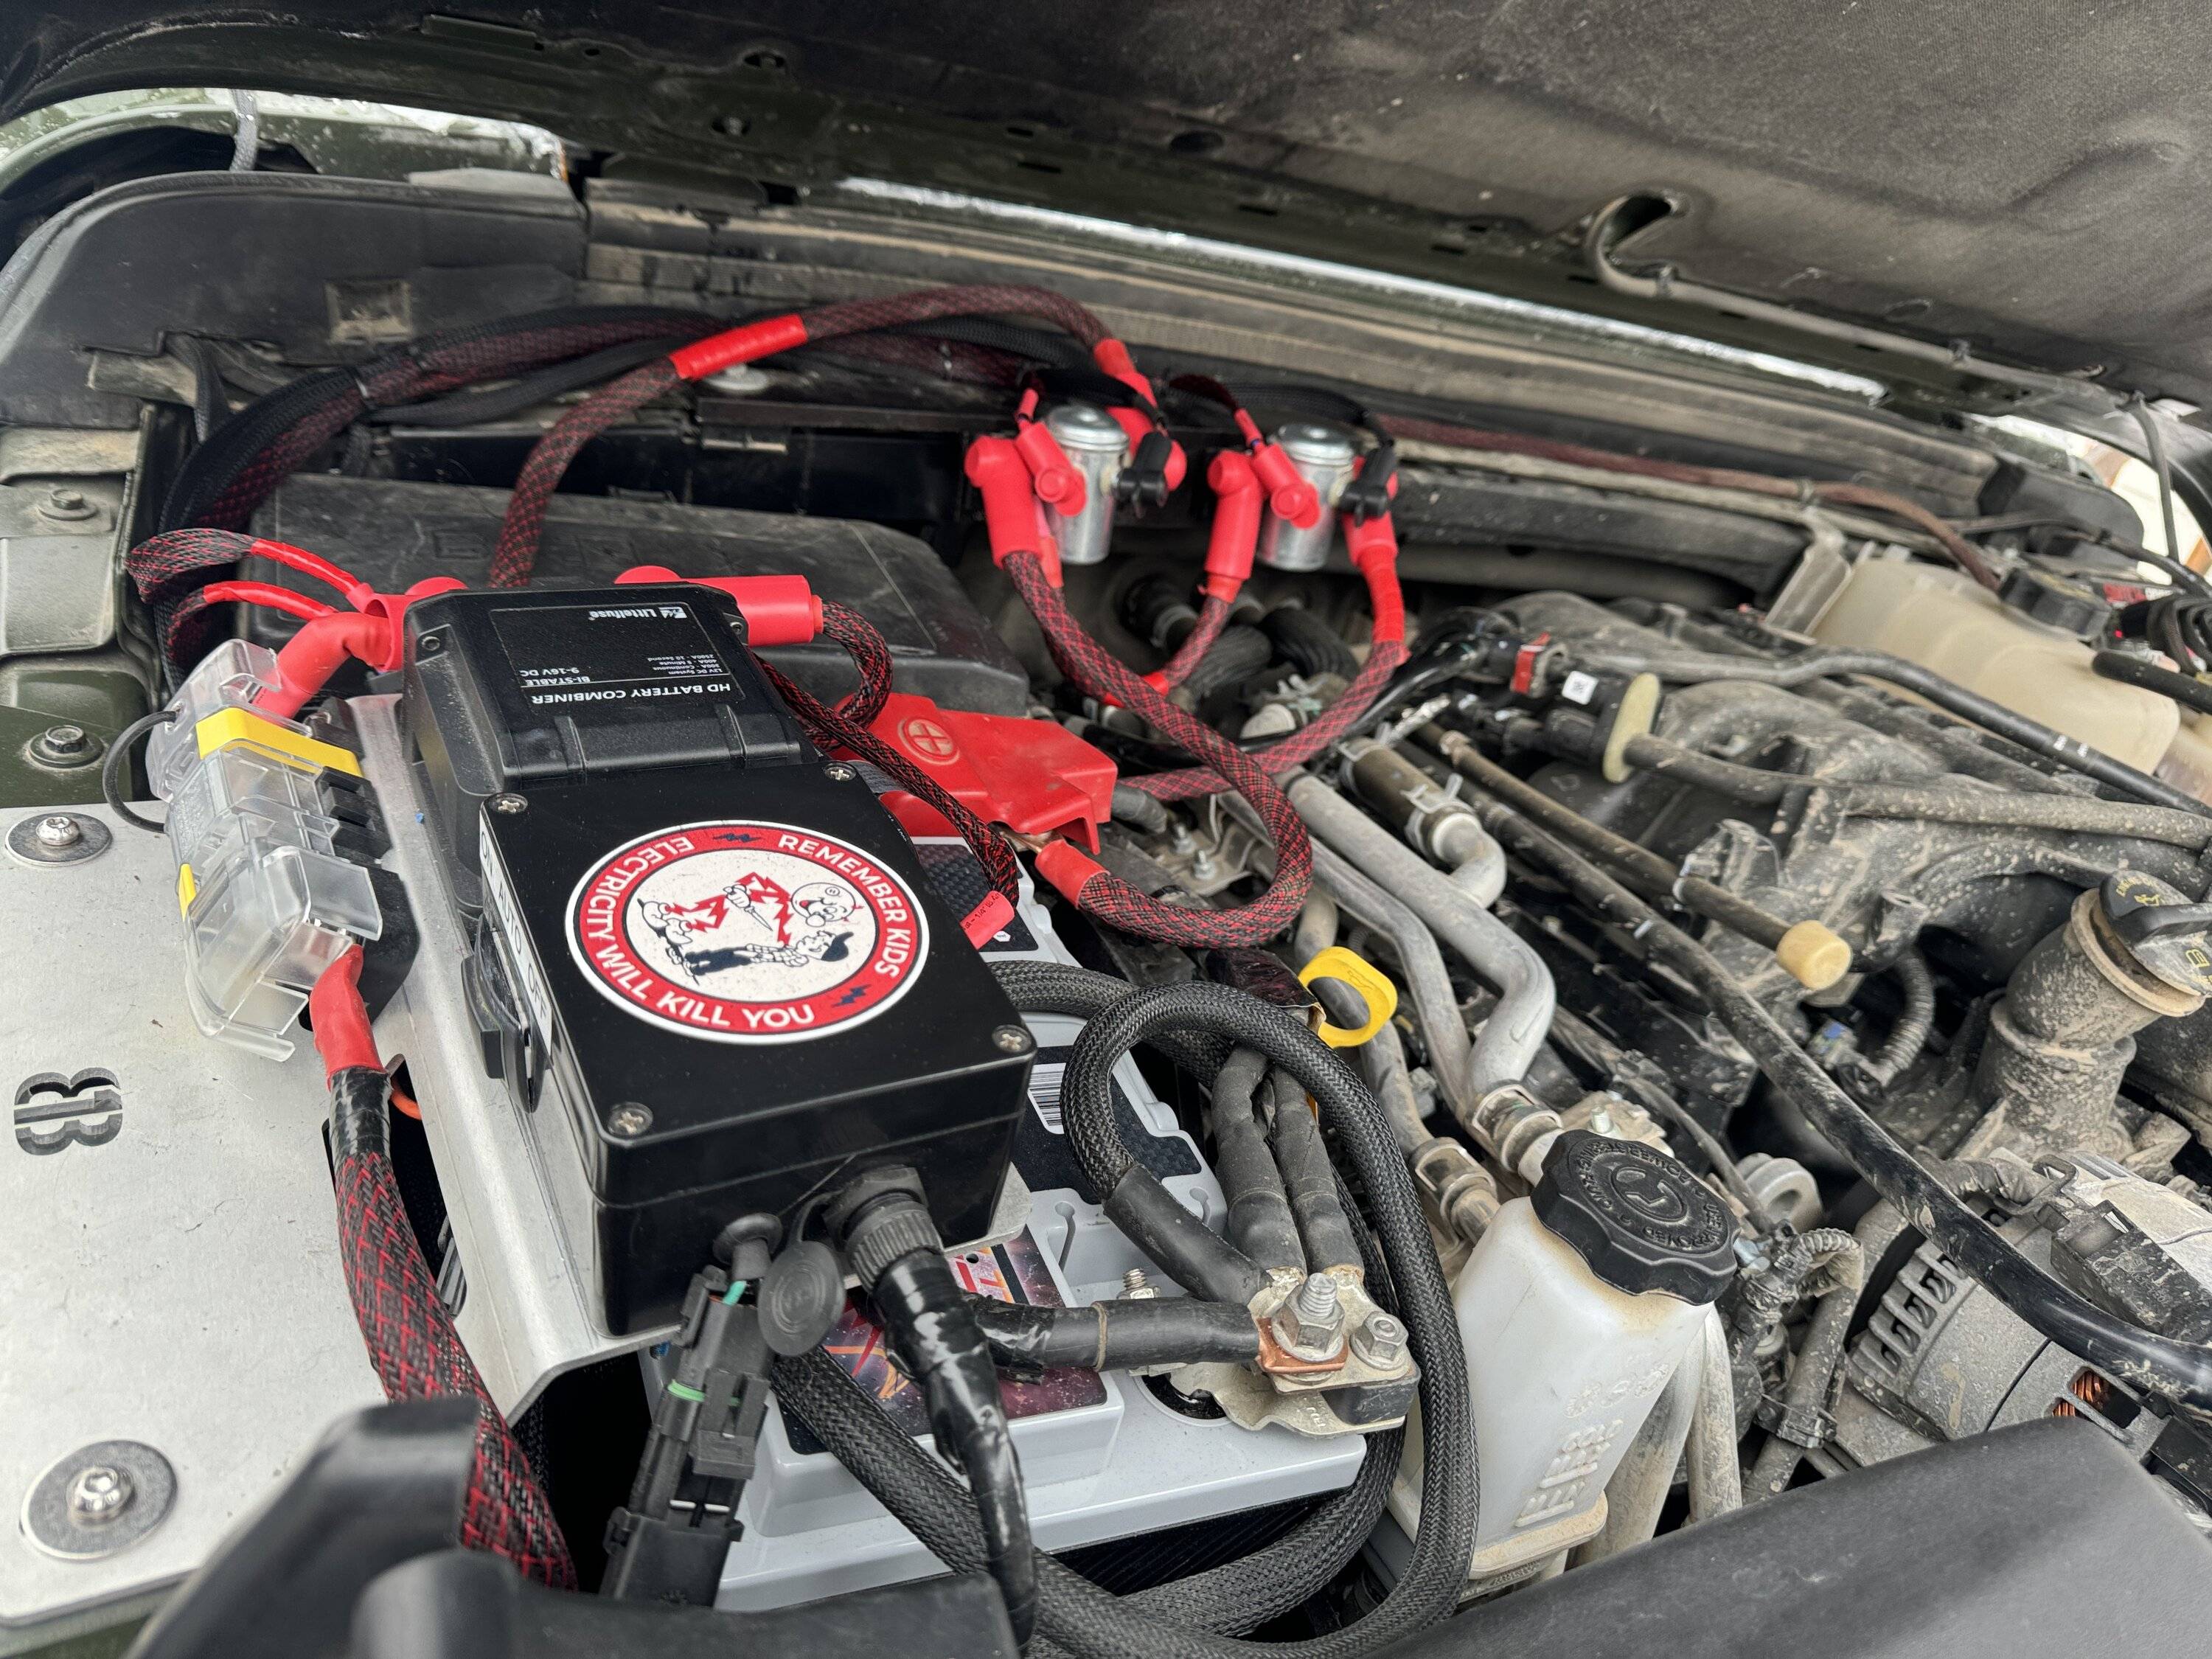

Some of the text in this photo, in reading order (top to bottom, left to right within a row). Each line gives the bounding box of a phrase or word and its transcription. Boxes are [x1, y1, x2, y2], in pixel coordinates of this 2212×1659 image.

[525, 676, 591, 686] BI-STABLE
[531, 683, 731, 704] HD BATTERY COMBINER
[481, 830, 546, 1019] ON AUTO OFF
[586, 836, 815, 1028] ELECTRICITY WILL KILL YOU
[777, 833, 911, 978] REMEMBER KIDS
[1576, 1141, 1692, 1212] POWER STEERING FLUID
[1643, 1203, 1722, 1251] USE APPROVED
